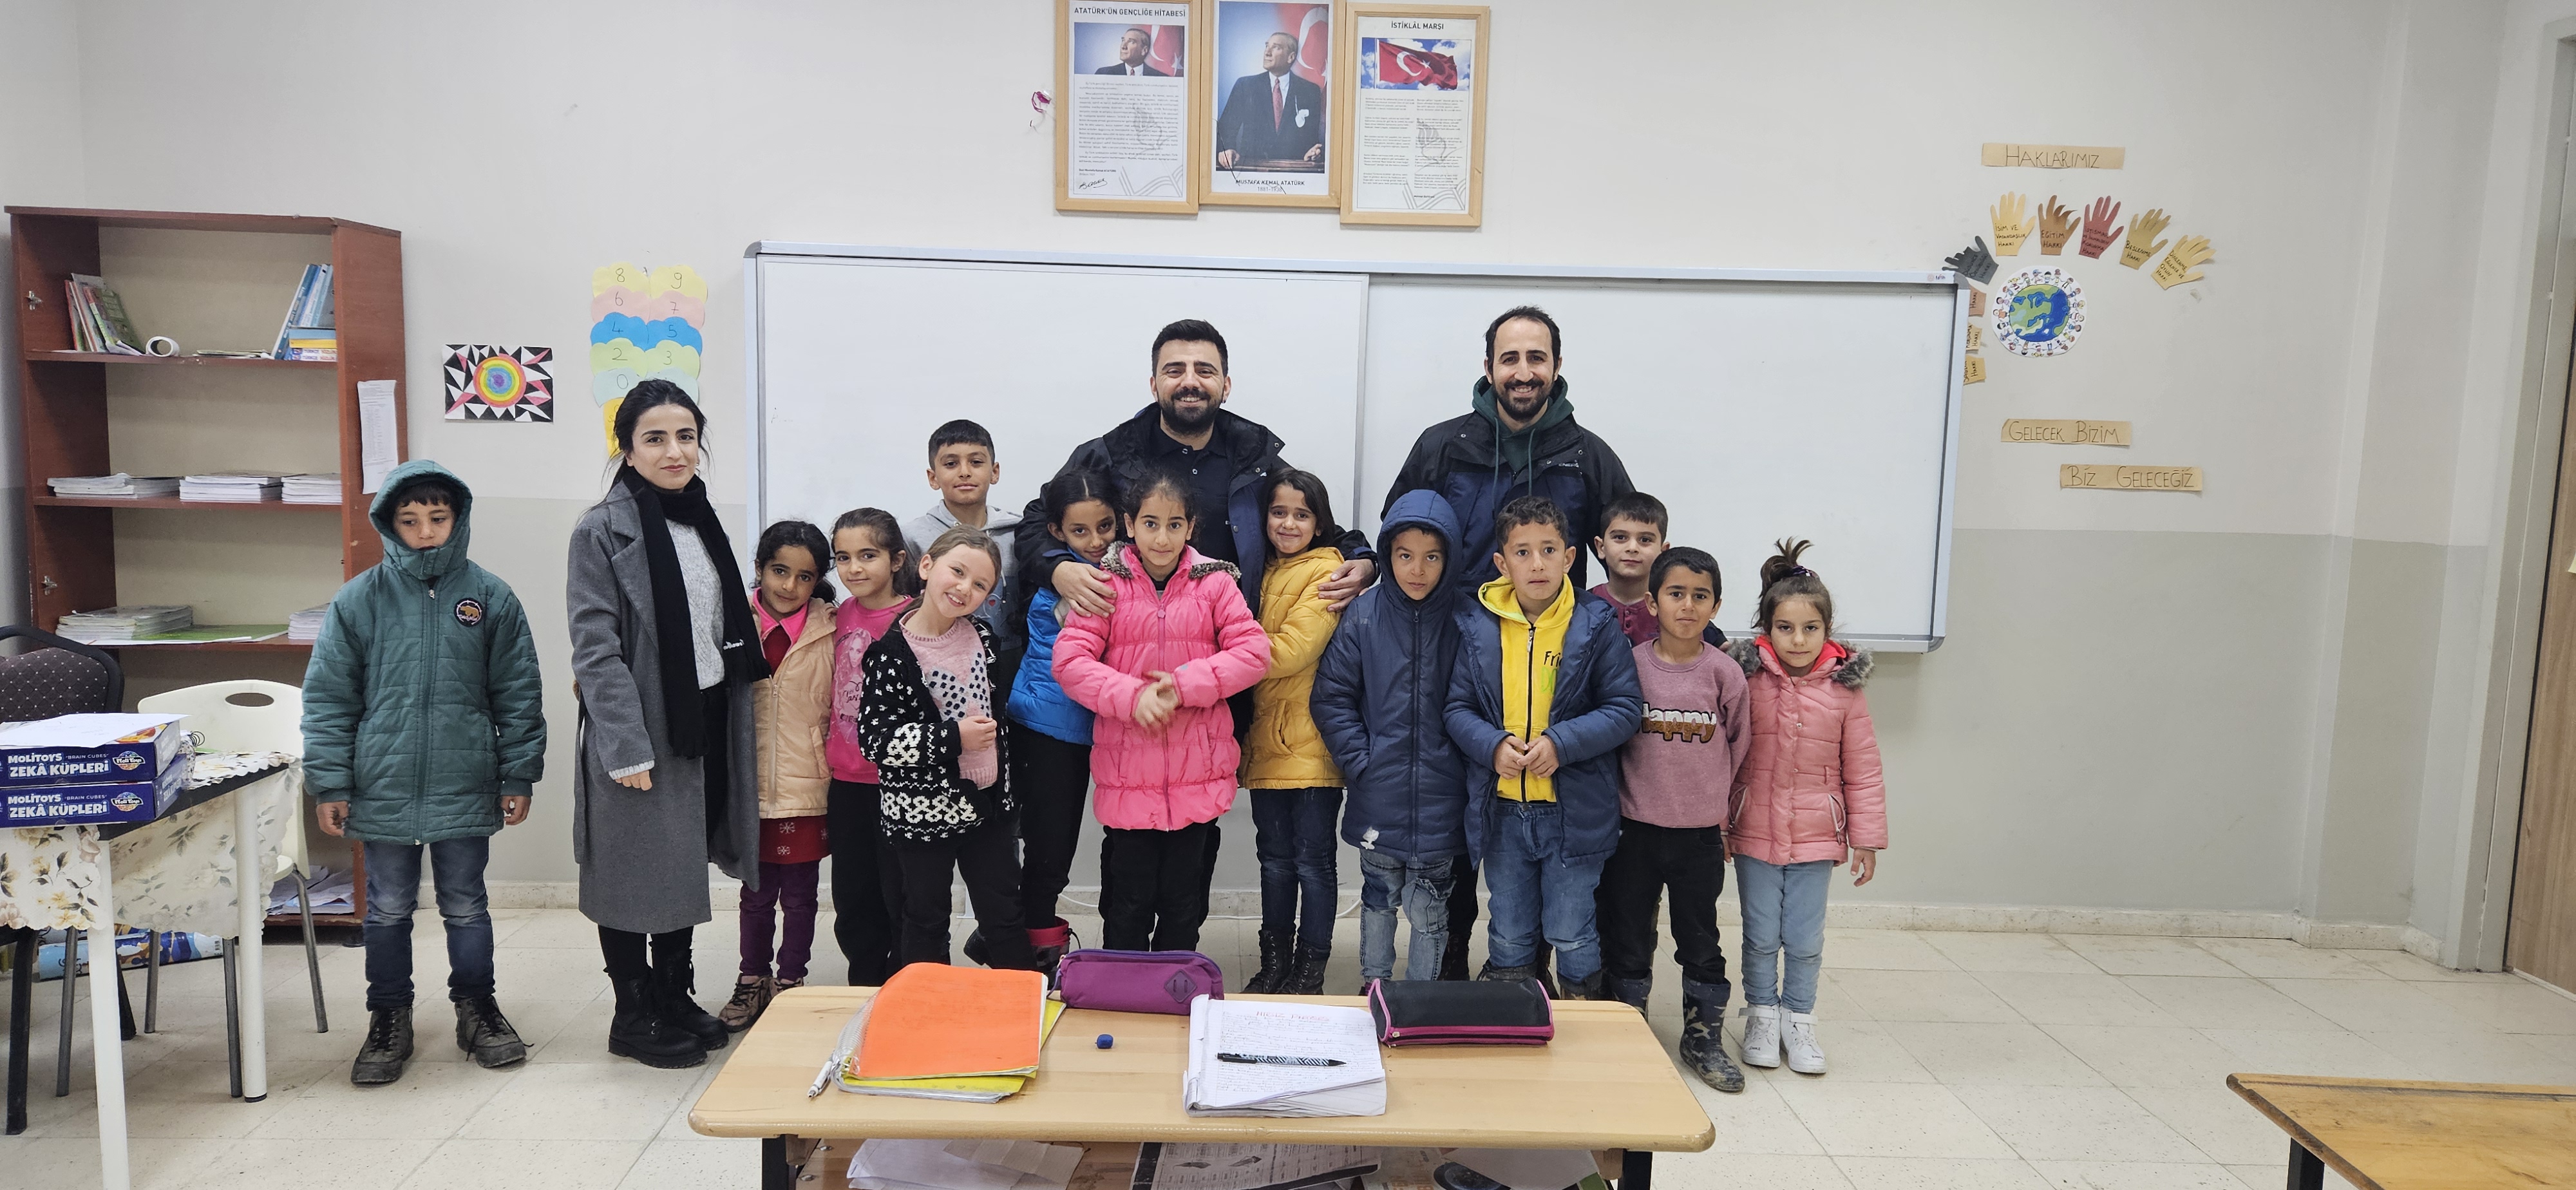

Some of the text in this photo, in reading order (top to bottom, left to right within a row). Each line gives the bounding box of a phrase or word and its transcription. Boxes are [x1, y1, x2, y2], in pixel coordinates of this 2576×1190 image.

[1155, 8, 1186, 17] HİTABESİ
[1391, 21, 1421, 29] İSTİKLÂL
[2006, 144, 2099, 168] HAKLARIMIZ
[2126, 252, 2141, 262] HAKKI
[616, 267, 625, 283] 8
[671, 272, 682, 289] 9
[615, 291, 623, 307] 6
[670, 301, 679, 314] 7
[612, 321, 623, 334] 4
[667, 325, 677, 338] 5
[612, 347, 628, 361] 2
[663, 350, 672, 365] 3
[616, 374, 629, 390] 0
[2009, 420, 2119, 444] GELECEK BİZİM
[2065, 466, 2195, 488] BİZ GELECEĞİZ
[8, 752, 62, 764] MOLİTOYS
[10, 762, 48, 777] ZEKÂ
[50, 760, 109, 776] KÜPLERİ
[8, 793, 61, 804] MOLİTOYS
[10, 804, 46, 818] ZEKÂ
[49, 801, 108, 817] KÜPLERİ
